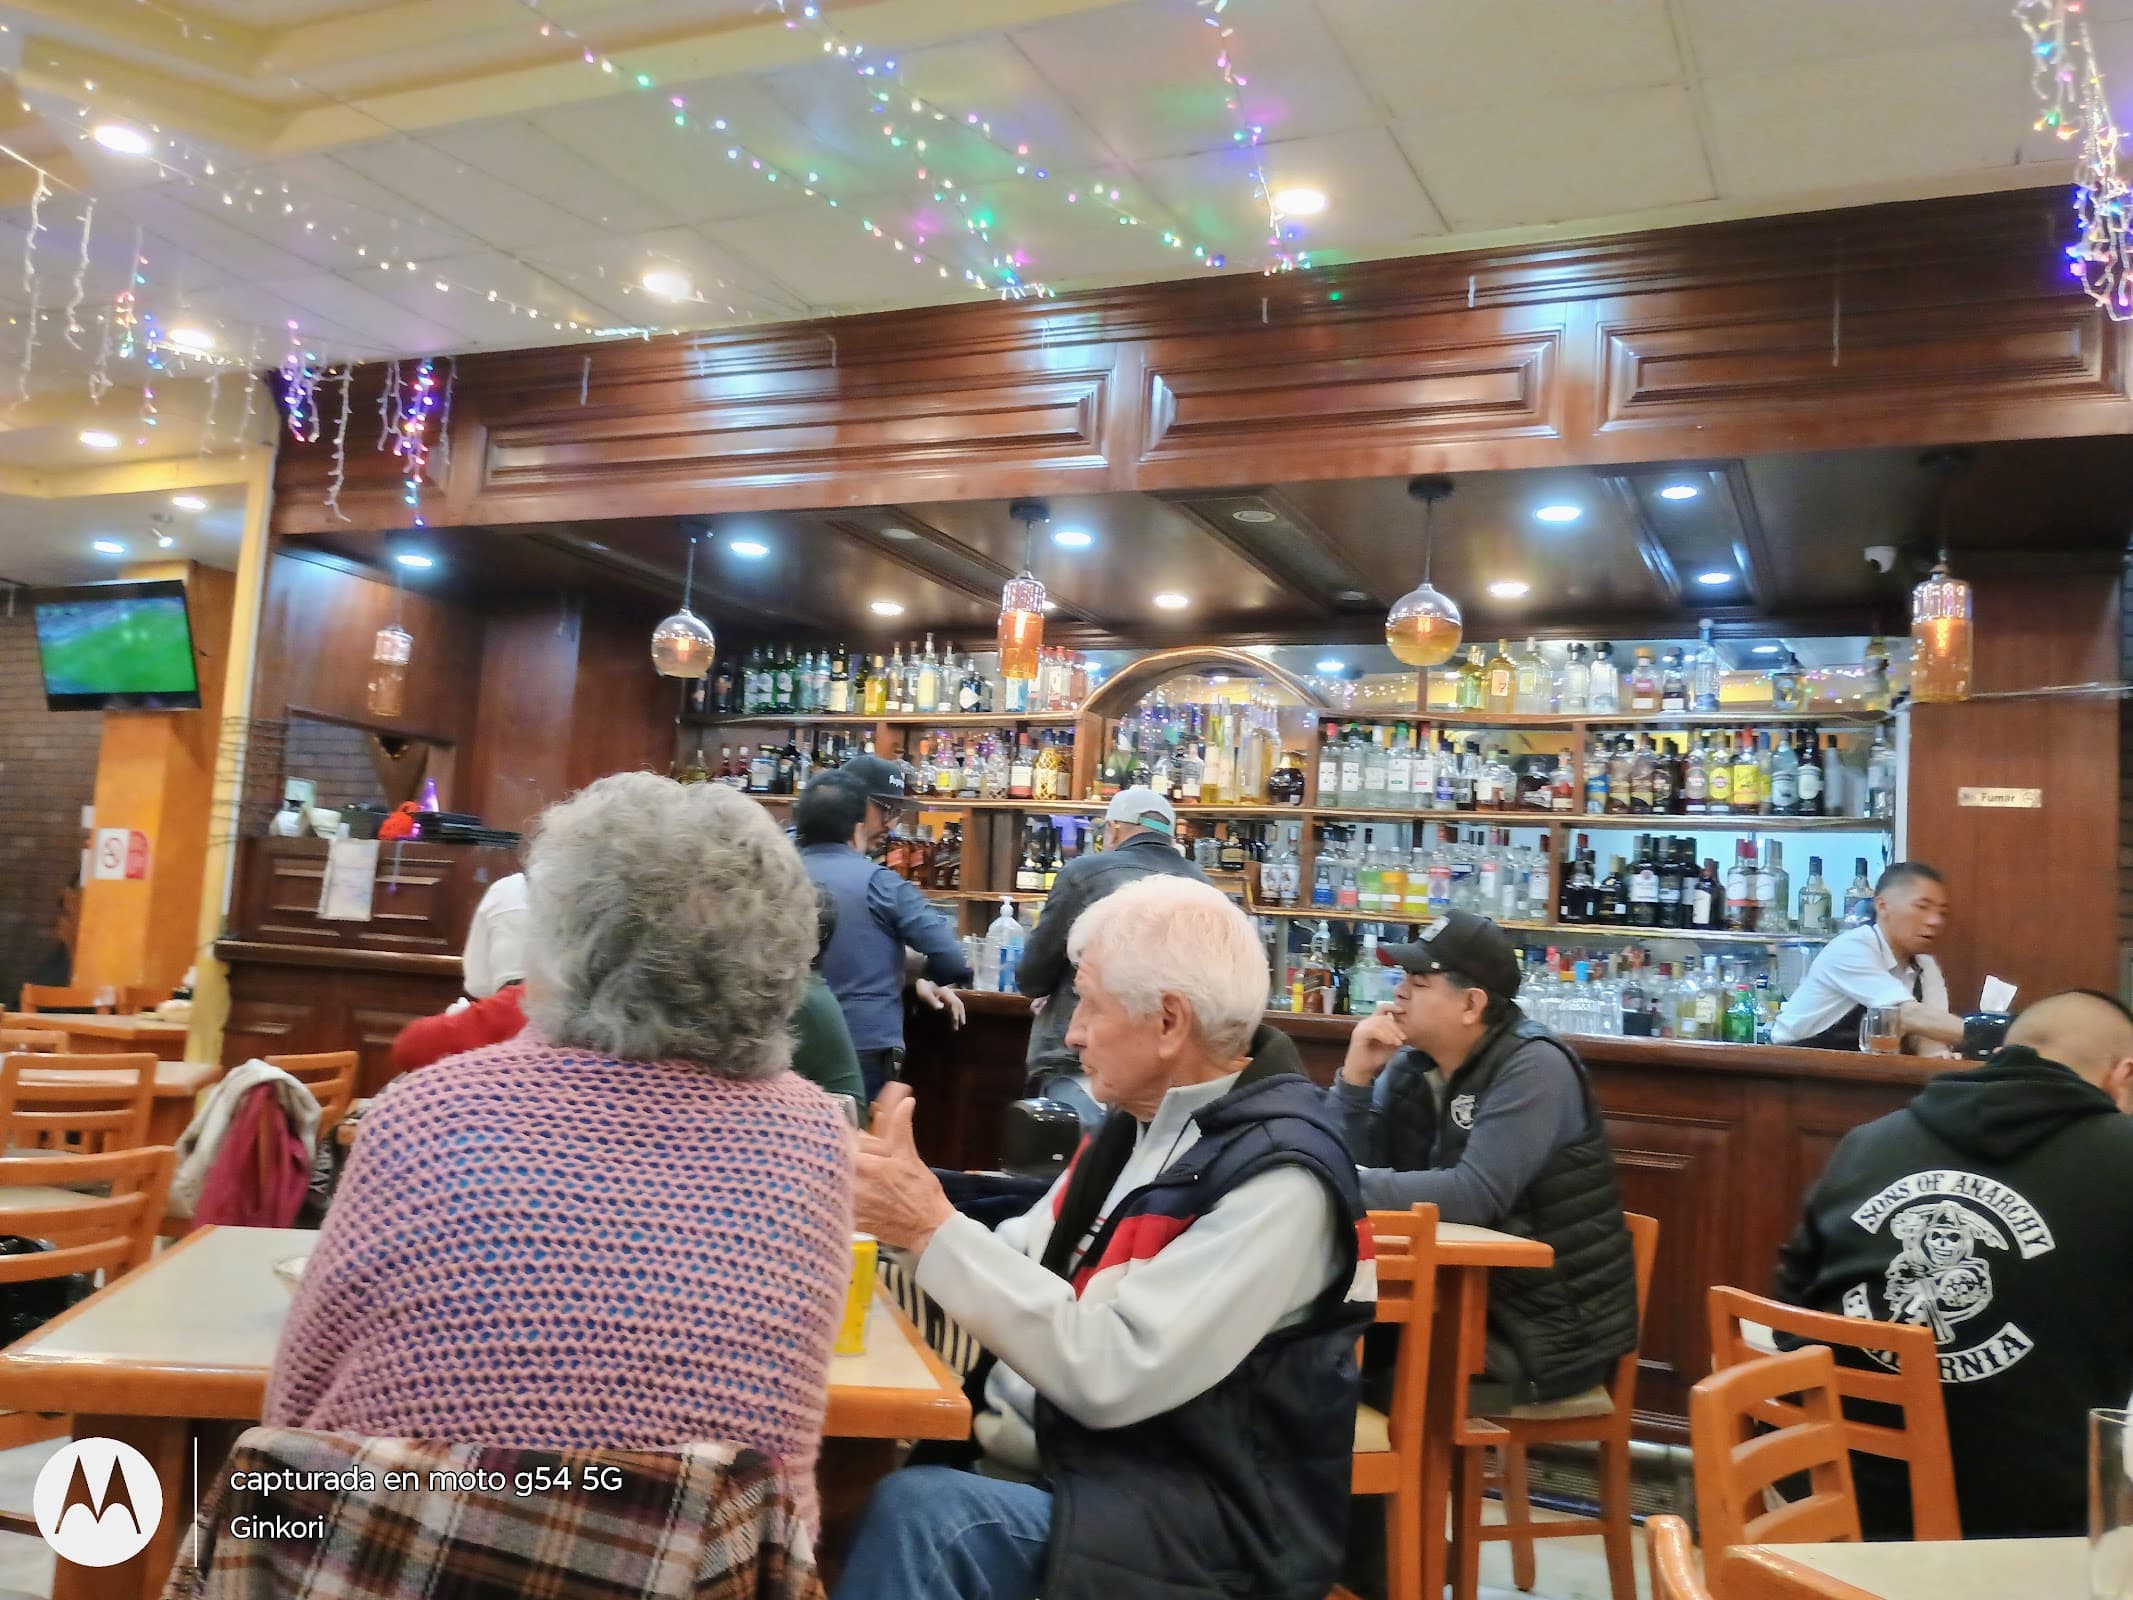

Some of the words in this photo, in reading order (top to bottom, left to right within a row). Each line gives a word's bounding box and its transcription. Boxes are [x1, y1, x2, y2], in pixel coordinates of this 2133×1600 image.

[1859, 1181, 1911, 1227] SONS
[1917, 1173, 1945, 1192] OF
[1951, 1175, 2050, 1248] ANARCHY
